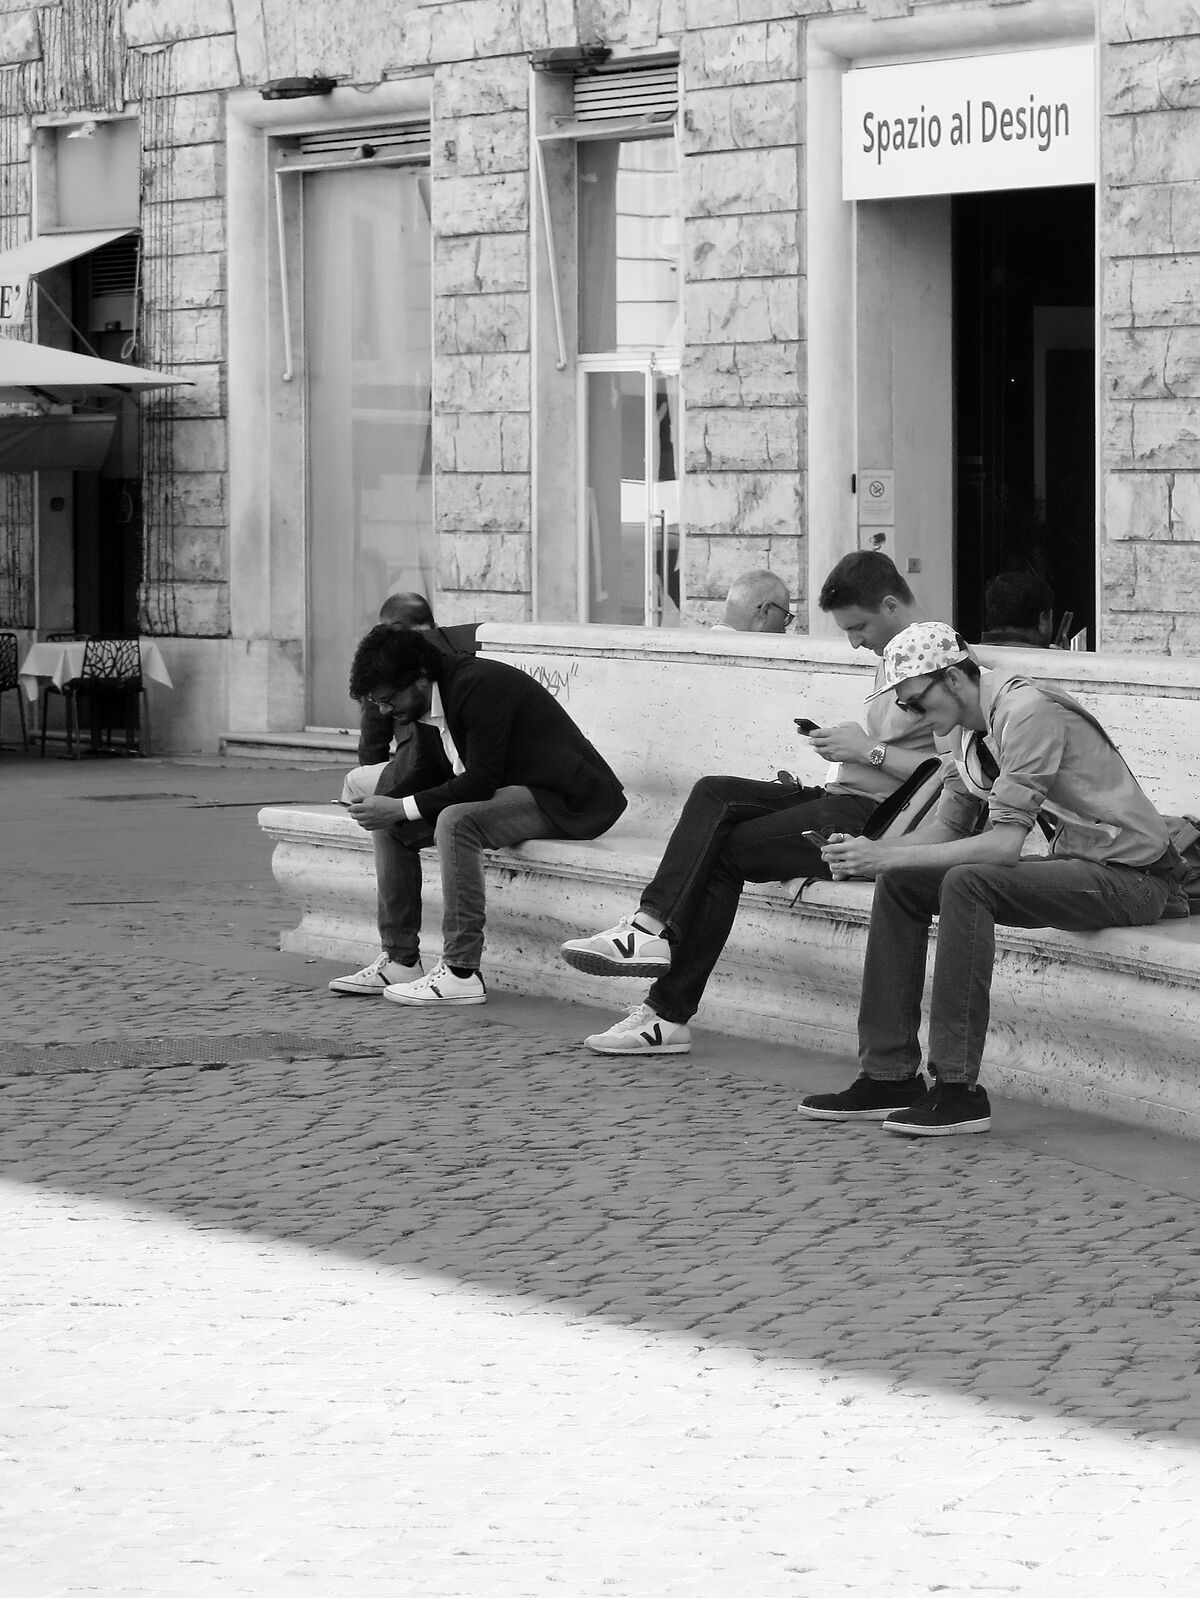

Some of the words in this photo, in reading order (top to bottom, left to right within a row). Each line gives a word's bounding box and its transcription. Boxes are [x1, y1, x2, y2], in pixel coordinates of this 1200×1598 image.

[863, 105, 942, 165] Spazio
[950, 100, 971, 146] al
[981, 94, 1070, 152] Design
